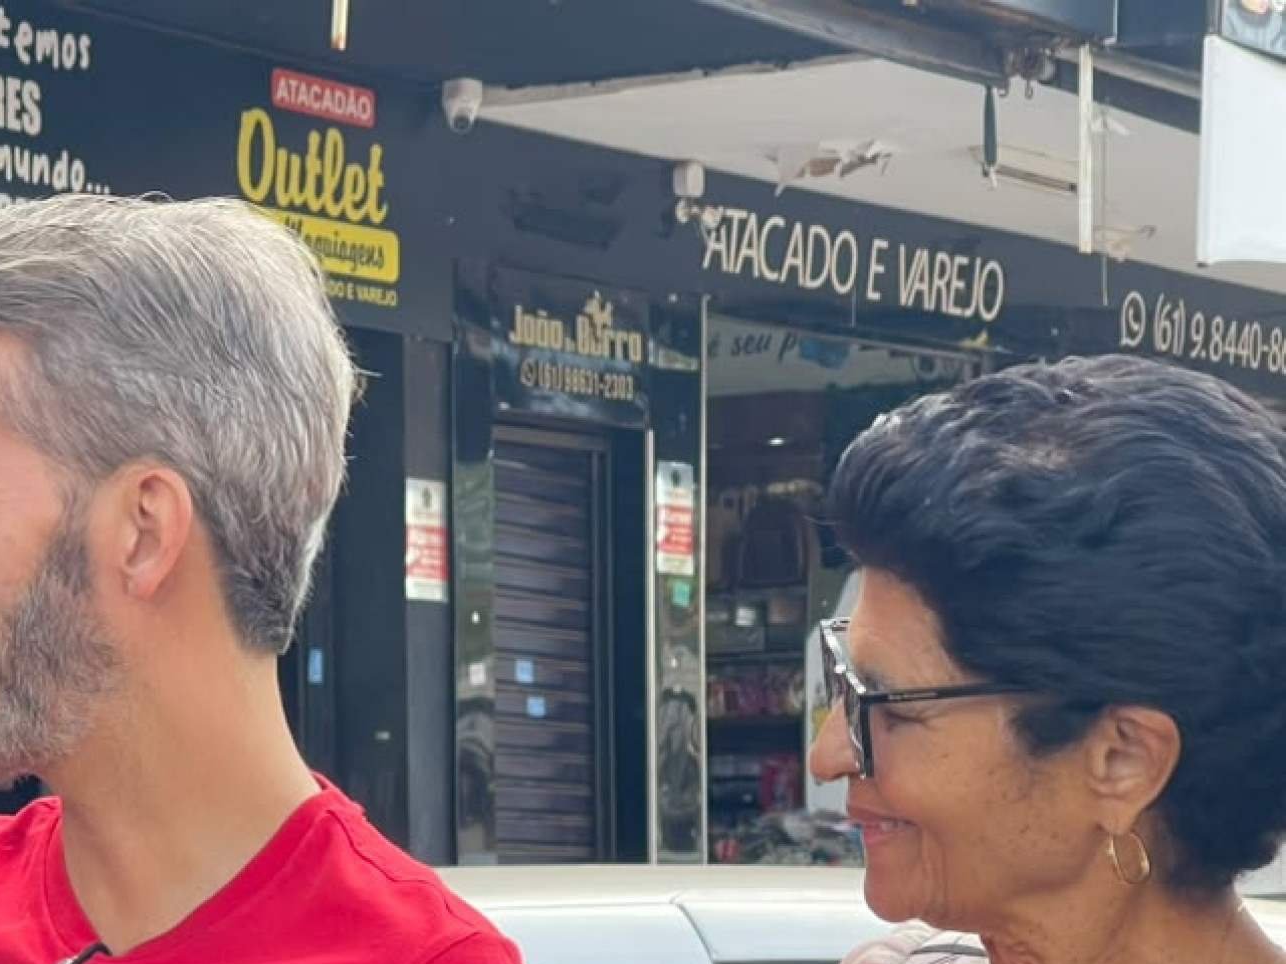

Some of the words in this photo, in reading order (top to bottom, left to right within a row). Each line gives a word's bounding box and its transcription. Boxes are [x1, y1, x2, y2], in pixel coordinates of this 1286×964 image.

[276, 77, 372, 121] ATACADÃO
[237, 107, 389, 224] Outlet
[702, 206, 859, 294] ATACADO
[866, 238, 889, 302] E
[898, 243, 1004, 322] VAREJO
[1153, 292, 1187, 357] (61)
